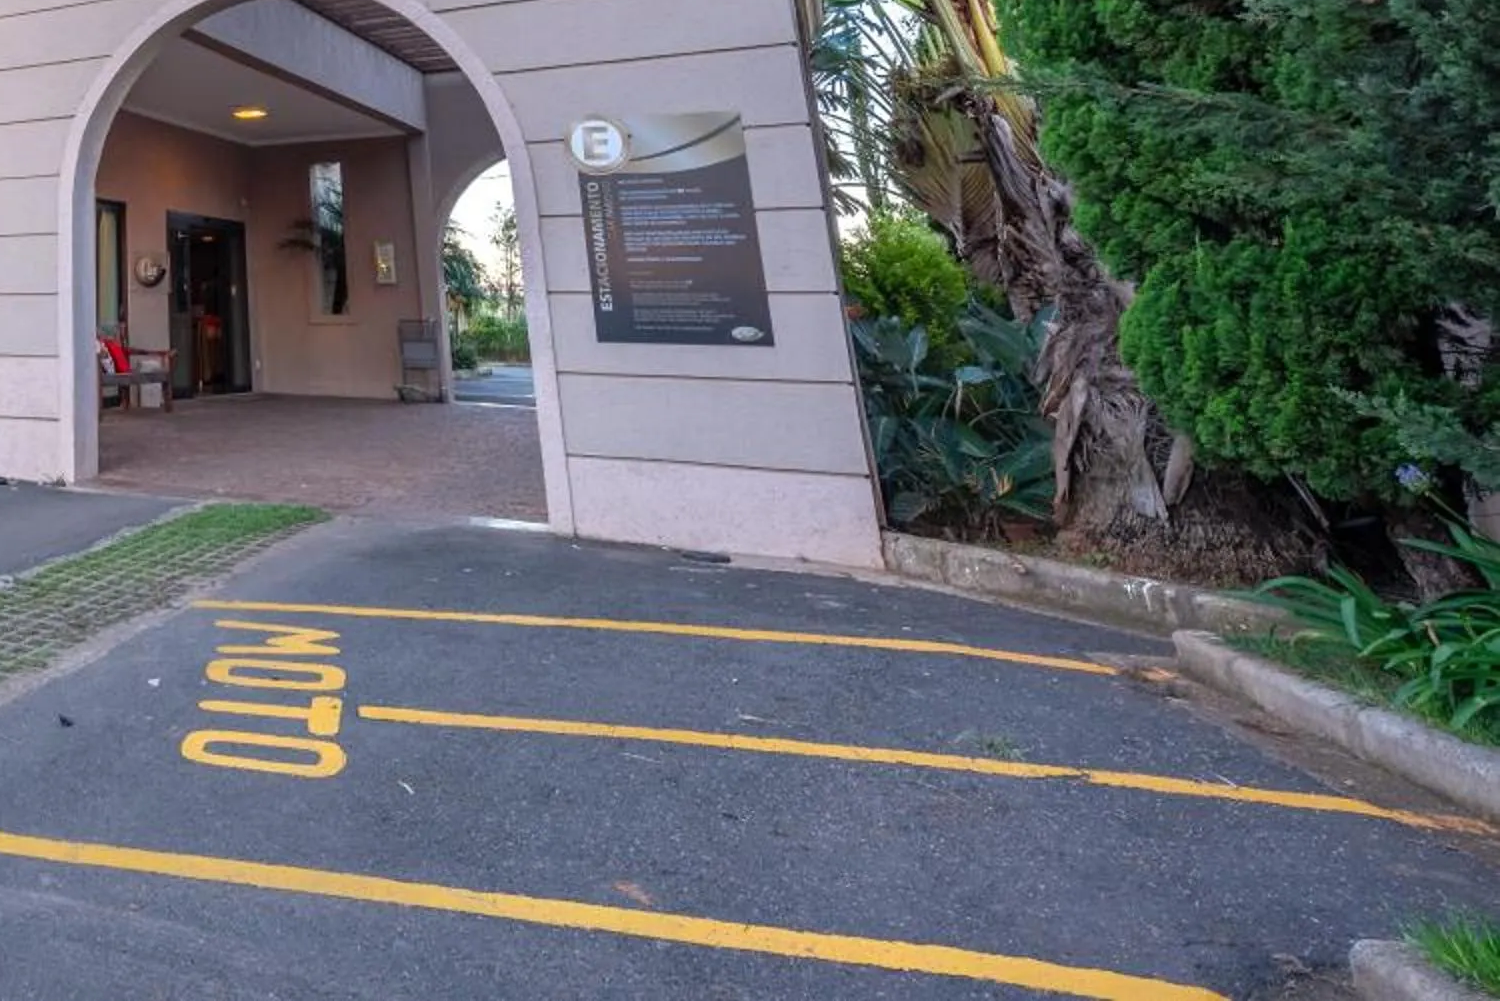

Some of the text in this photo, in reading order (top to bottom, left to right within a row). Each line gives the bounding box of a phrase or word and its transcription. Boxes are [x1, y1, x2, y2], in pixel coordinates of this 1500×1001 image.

[581, 126, 613, 161] E
[586, 182, 613, 311] ESTACIONAMENTO
[180, 619, 348, 779] MOTO
